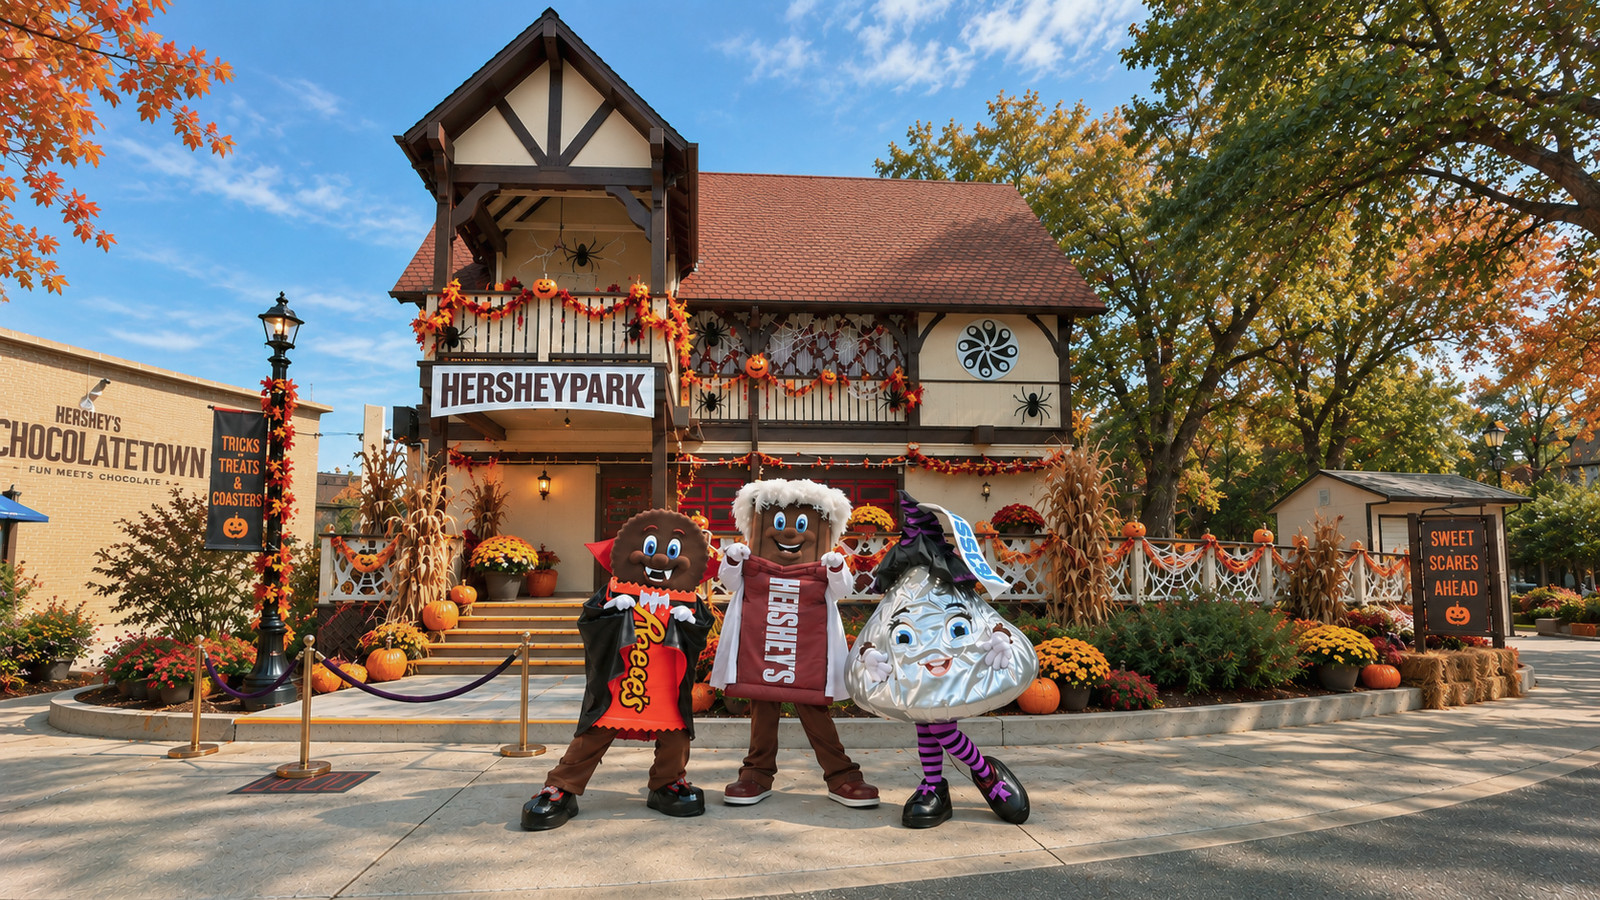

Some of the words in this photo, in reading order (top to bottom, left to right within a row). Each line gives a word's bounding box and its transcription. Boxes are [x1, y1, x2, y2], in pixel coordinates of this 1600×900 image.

[440, 372, 646, 409] HERSHEYPARK
[55, 405, 121, 433] HERSHEY'S
[0, 418, 207, 479] CHOCOLATETOWN
[221, 435, 260, 454] TRICKS
[218, 457, 260, 475] TREATS
[28, 465, 51, 475] FUN
[56, 468, 94, 480] MEETS
[98, 473, 161, 486] CHOCOLATE
[233, 476, 242, 490] &
[212, 491, 263, 508] COASTERS
[1431, 530, 1475, 547] SWEET
[1429, 555, 1479, 571] SCARES
[1434, 580, 1479, 597] AHEAD
[762, 577, 801, 684] HERSHEY'S
